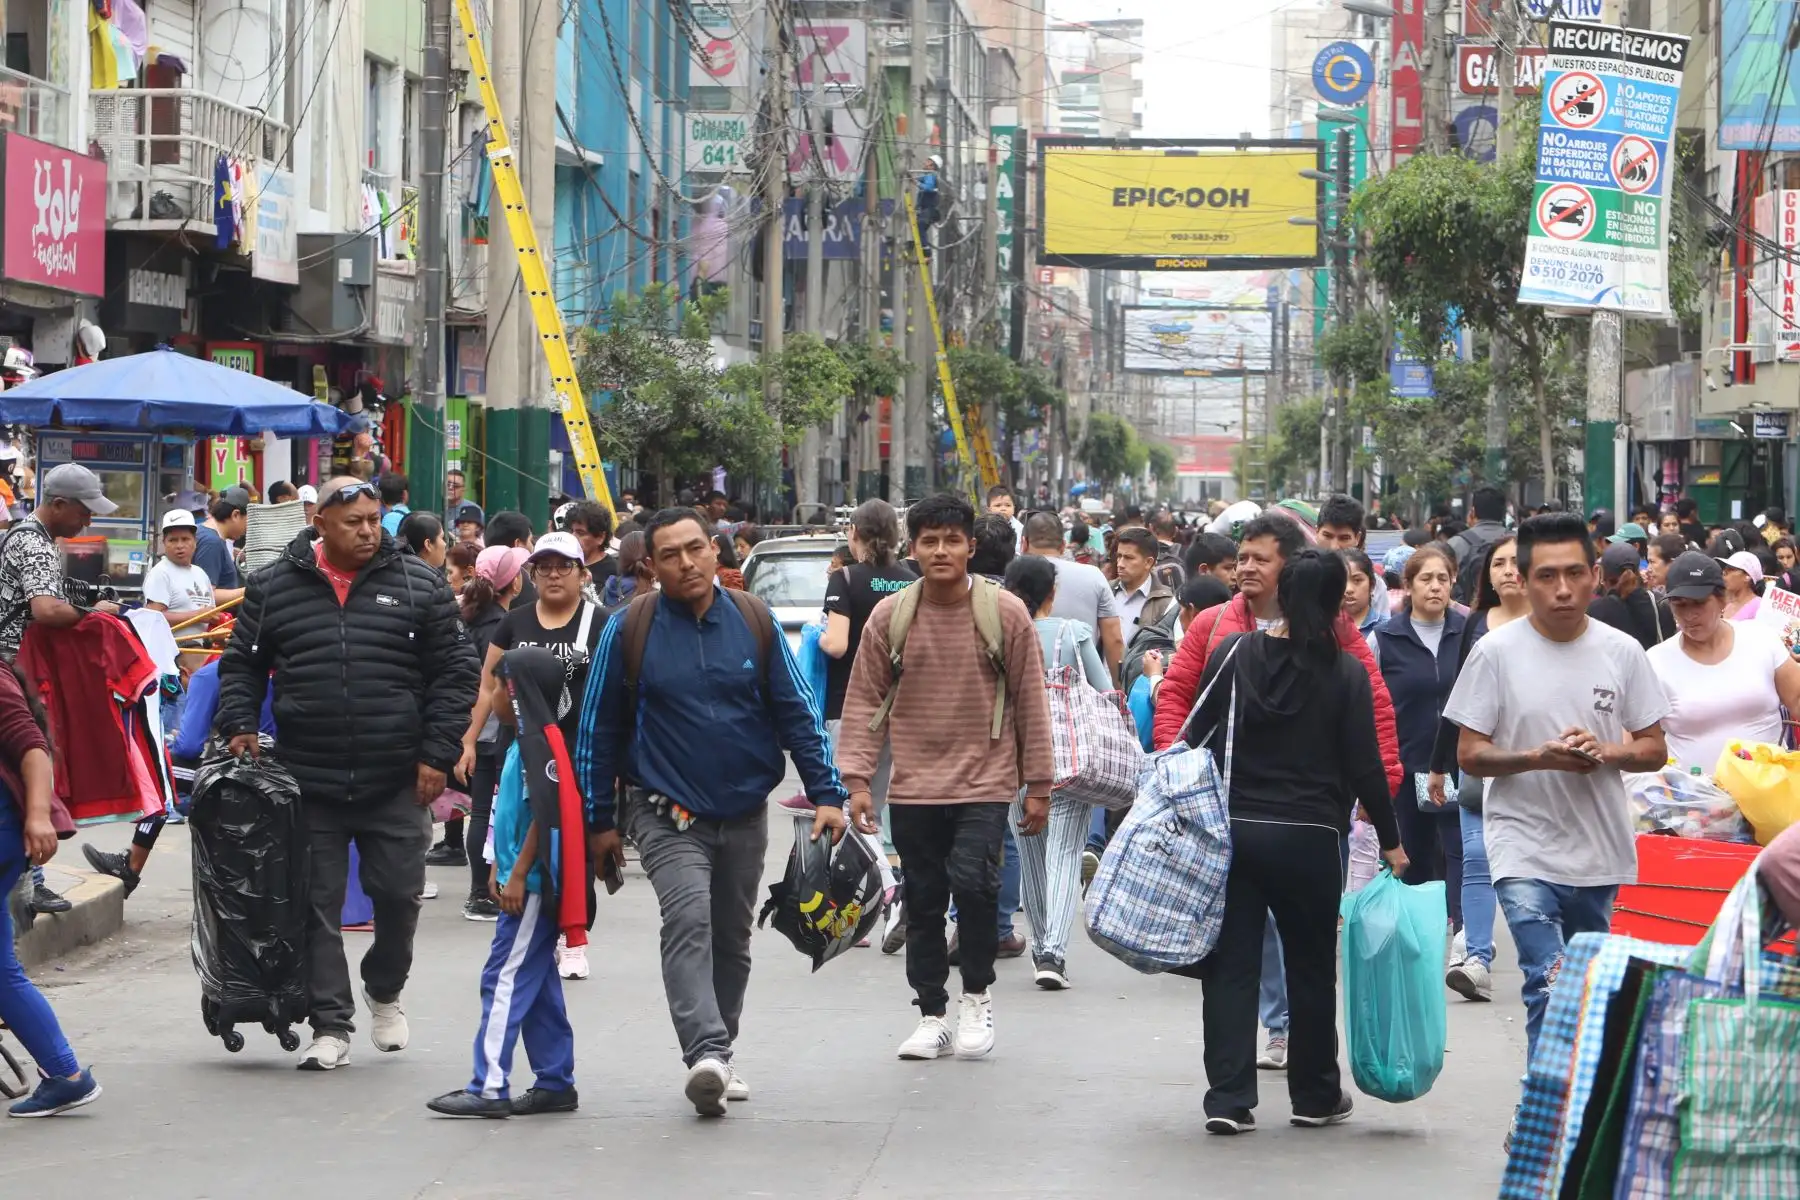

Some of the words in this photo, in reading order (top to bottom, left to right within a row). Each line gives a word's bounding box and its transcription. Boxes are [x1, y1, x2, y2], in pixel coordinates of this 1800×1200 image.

[1553, 28, 1683, 63] RECUPEREMOS
[1552, 58, 1596, 71] NUESTROS
[1616, 83, 1635, 98] NO
[1635, 92, 1671, 106] APOYES
[692, 121, 746, 141] GAMARRA
[1542, 132, 1567, 146] NO
[1567, 140, 1607, 151] ARROJES
[703, 145, 736, 165] 641
[1542, 147, 1608, 162] DESPERDICIOS
[1540, 166, 1553, 176] LA
[1541, 157, 1552, 166] NI
[1553, 159, 1591, 171] BASURA
[1593, 162, 1604, 172] EN
[1634, 201, 1656, 216] NO
[1606, 219, 1619, 231] EN
[1538, 244, 1569, 256] CONOCES
[1592, 250, 1609, 261] ACTO
[1594, 265, 1604, 273] AL
[1782, 192, 1797, 331] CORTINAS
[1542, 267, 1566, 280] 510
[1569, 270, 1604, 284] 2070
